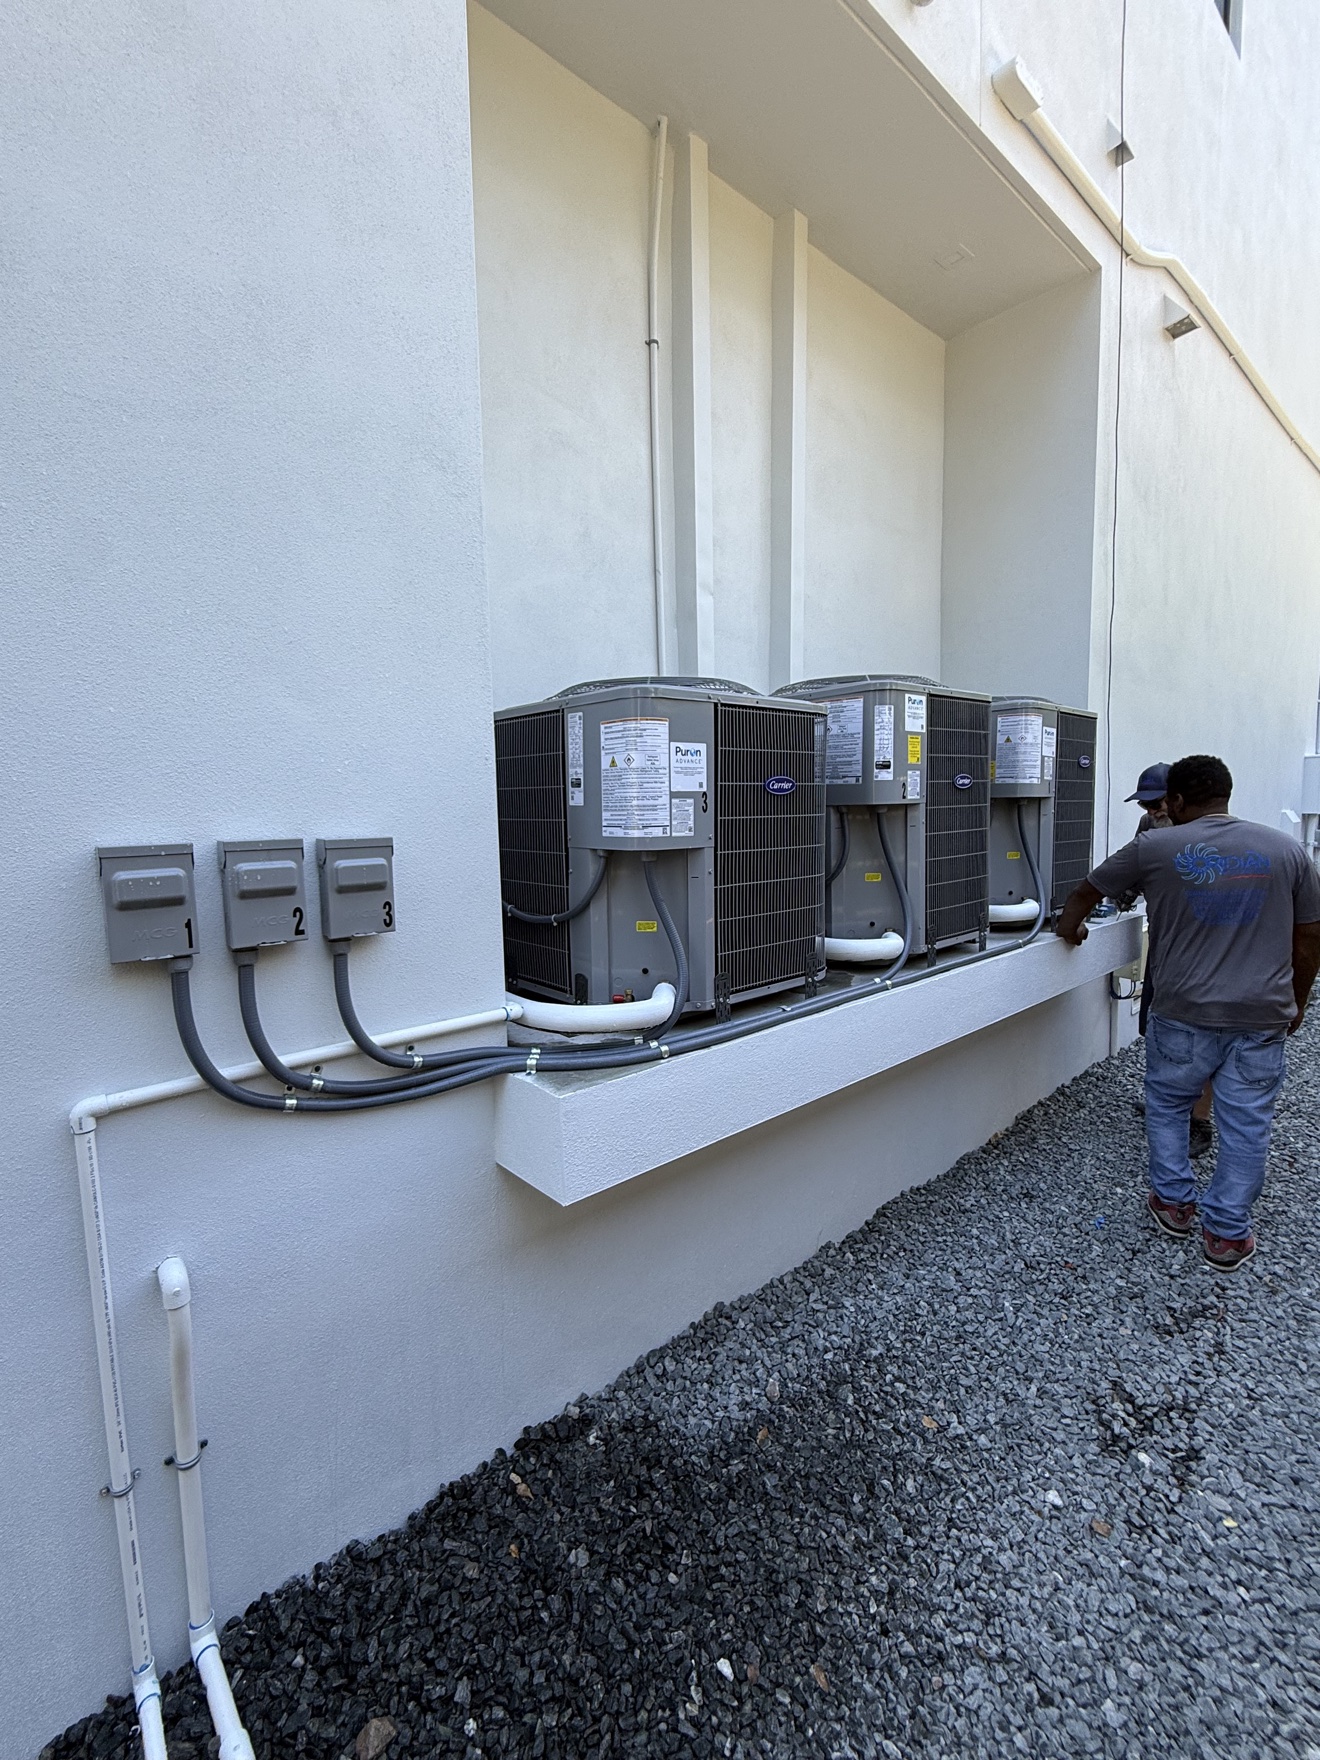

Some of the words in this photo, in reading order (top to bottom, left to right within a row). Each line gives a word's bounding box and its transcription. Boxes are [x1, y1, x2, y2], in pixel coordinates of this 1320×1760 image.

[675, 746, 702, 758] Puron
[769, 780, 793, 790] Carrier
[901, 782, 907, 799] 2
[701, 791, 708, 813] 3
[292, 906, 306, 936] 2
[382, 900, 393, 928] 3
[131, 926, 179, 943] MCG
[184, 918, 194, 949] 1
